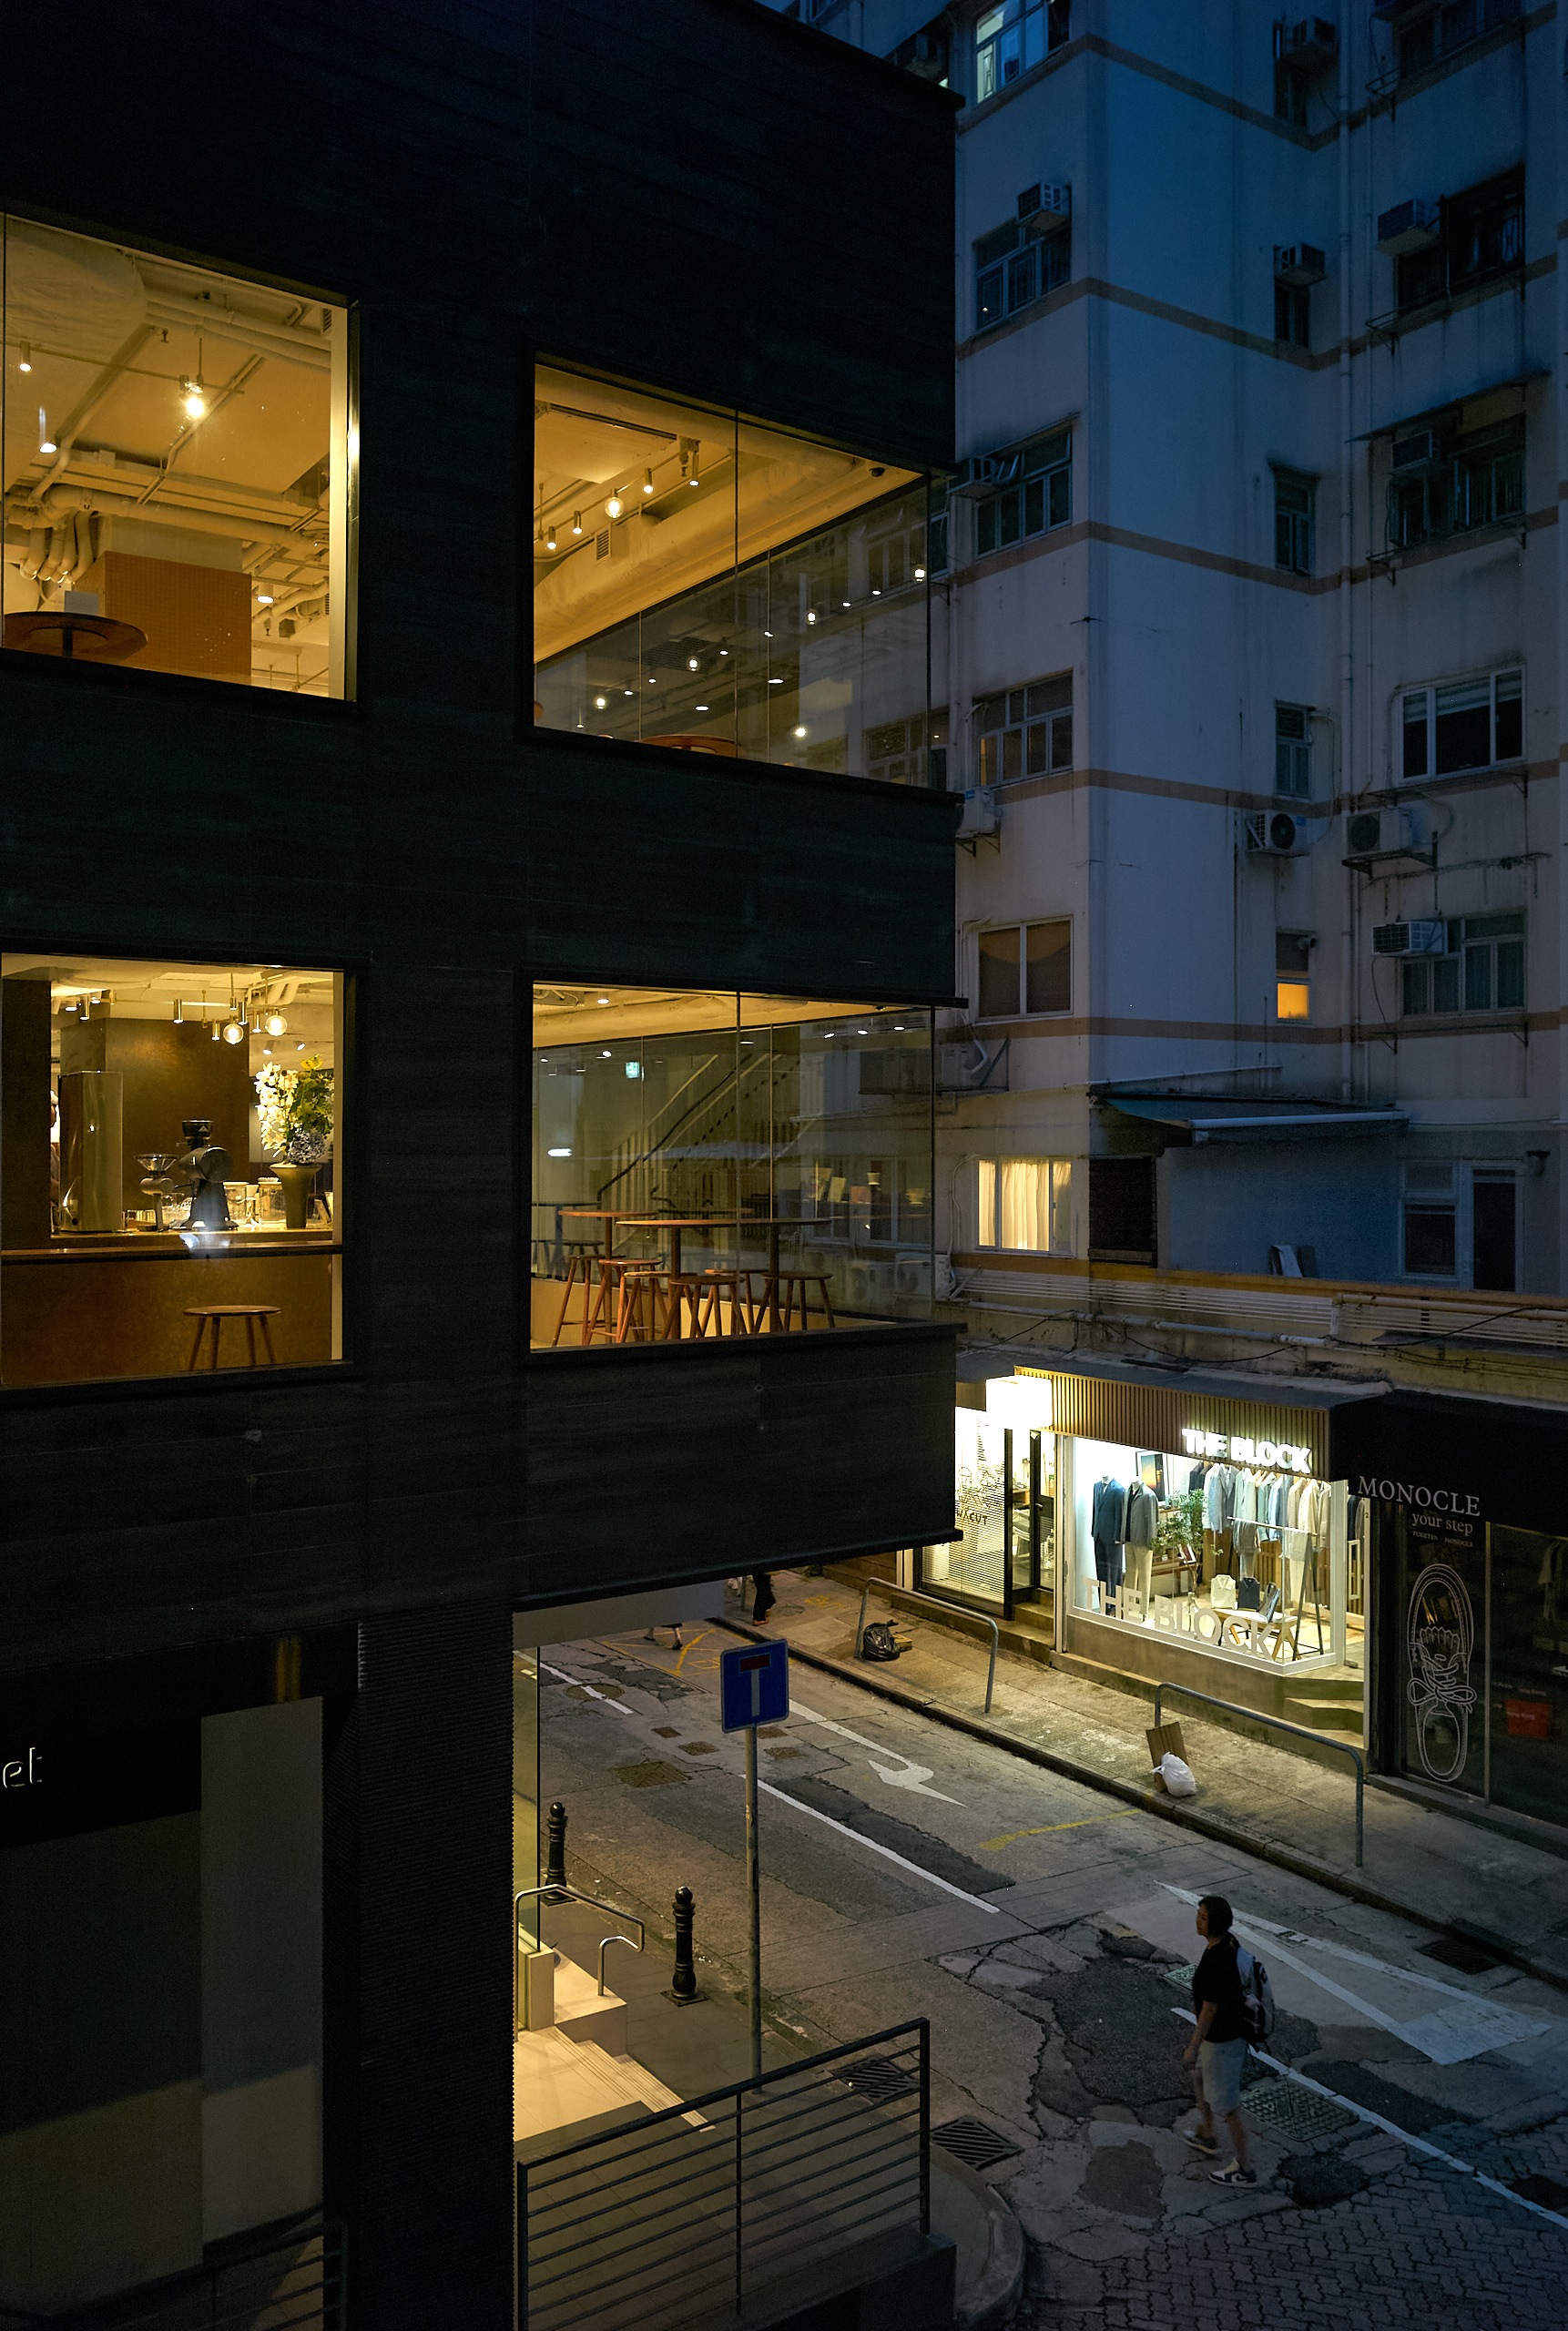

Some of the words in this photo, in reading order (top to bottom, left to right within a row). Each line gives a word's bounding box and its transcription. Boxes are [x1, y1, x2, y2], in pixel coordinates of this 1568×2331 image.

[1182, 1428, 1227, 1458] THE
[1231, 1436, 1311, 1474] BLOCK
[1358, 1475, 1481, 1517] MONOCLE
[1412, 1513, 1442, 1528] your
[1445, 1519, 1473, 1536] step
[1082, 1576, 1143, 1625] THE
[1155, 1594, 1275, 1662] BLOCK
